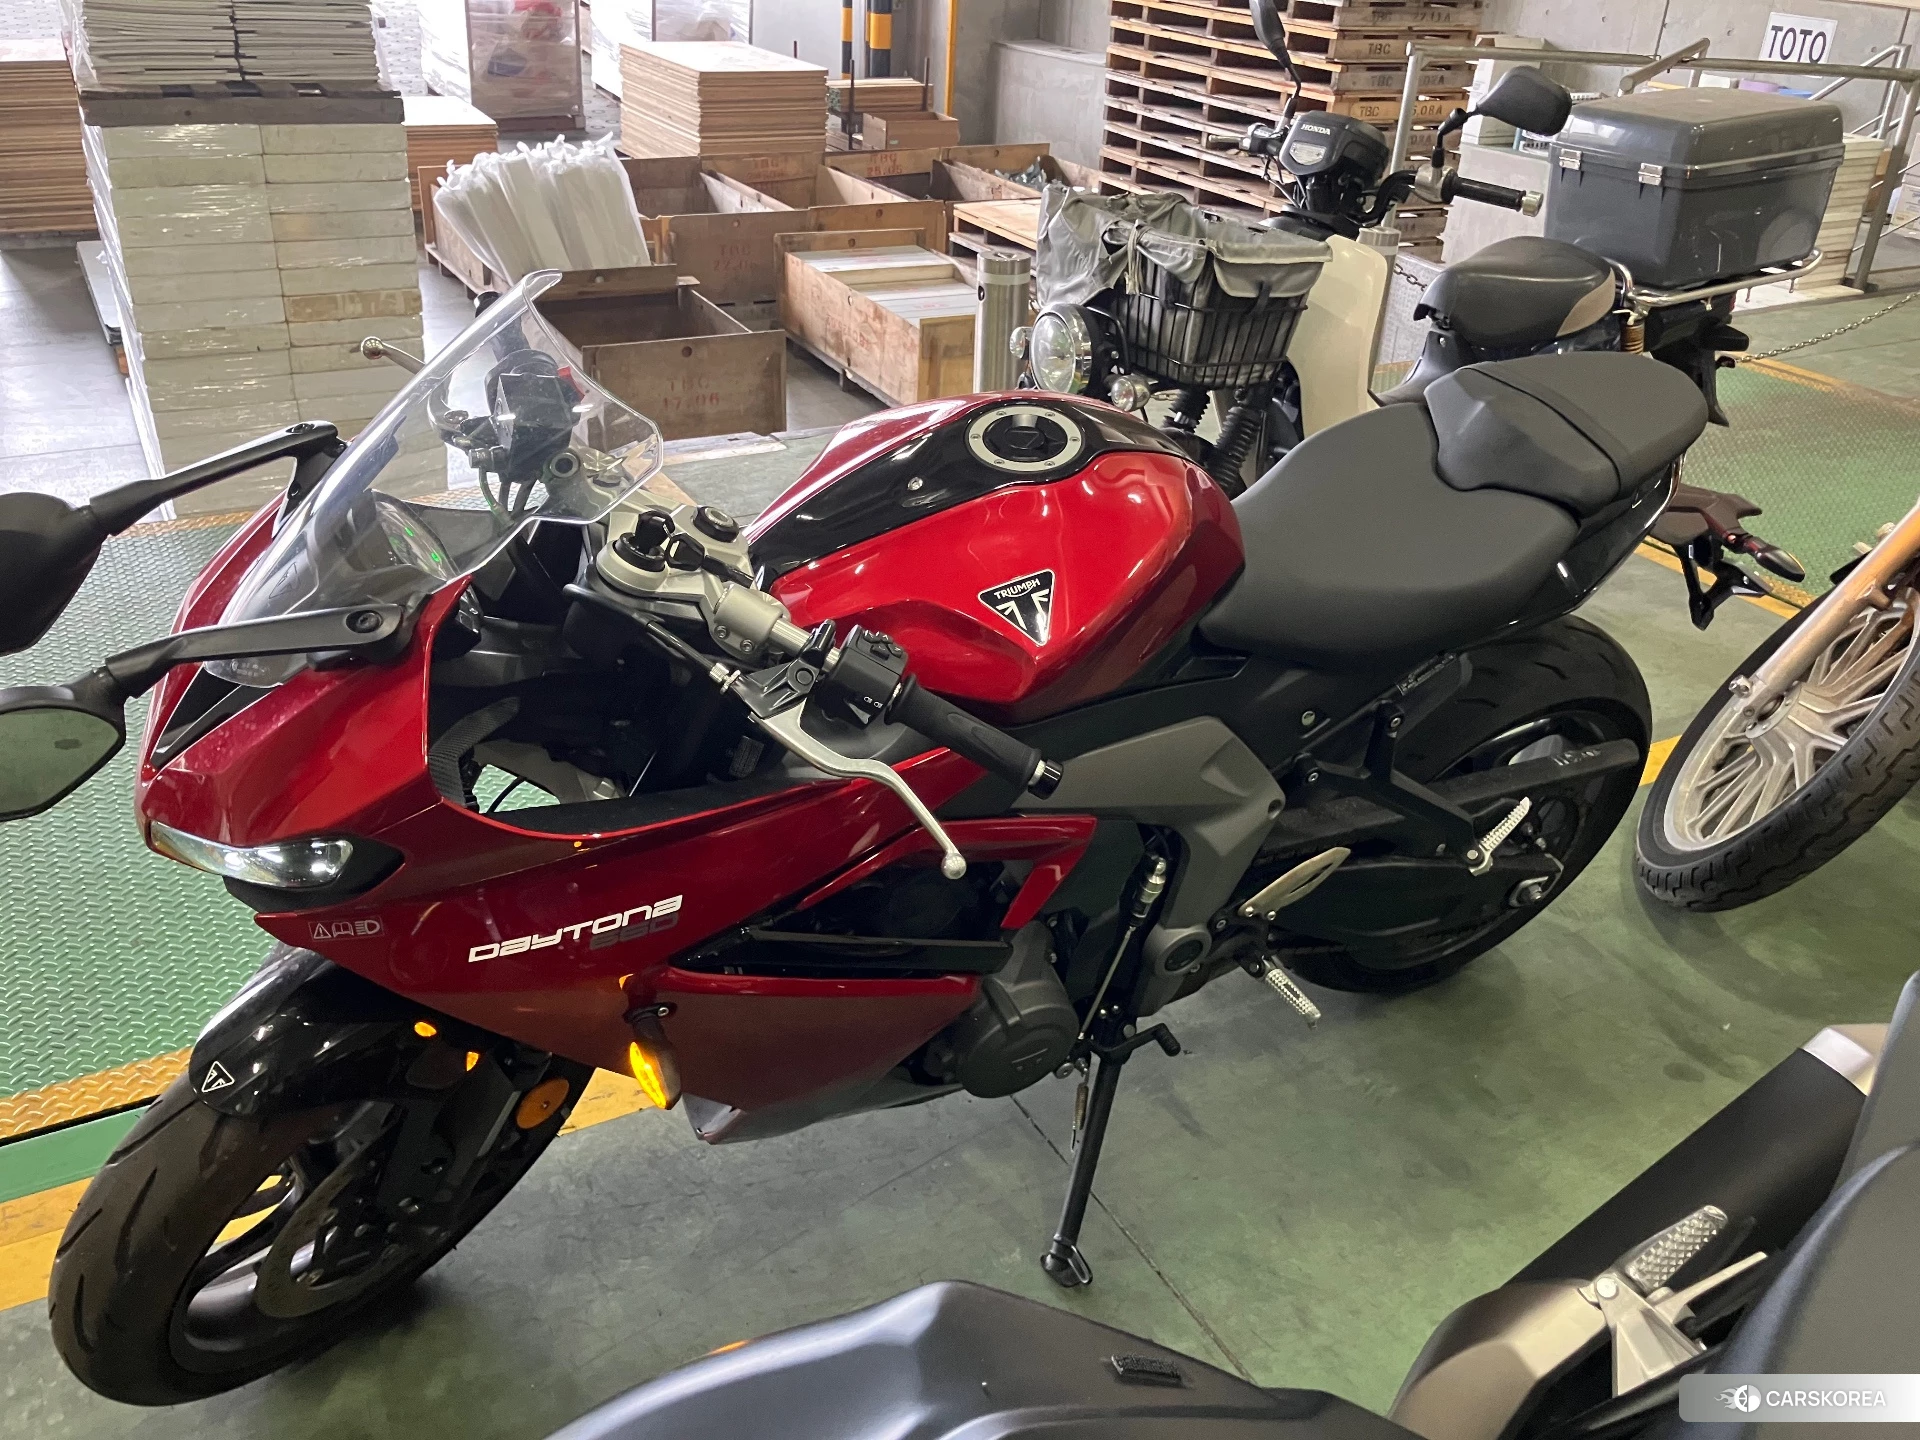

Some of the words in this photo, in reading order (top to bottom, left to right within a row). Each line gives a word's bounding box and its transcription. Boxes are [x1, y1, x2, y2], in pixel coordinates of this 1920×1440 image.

[1367, 43, 1391, 55] TBC
[1768, 25, 1827, 64] TOTO
[1359, 106, 1380, 117] TBC
[1301, 124, 1331, 135] HONDA
[994, 578, 1041, 599] TRIUMPH
